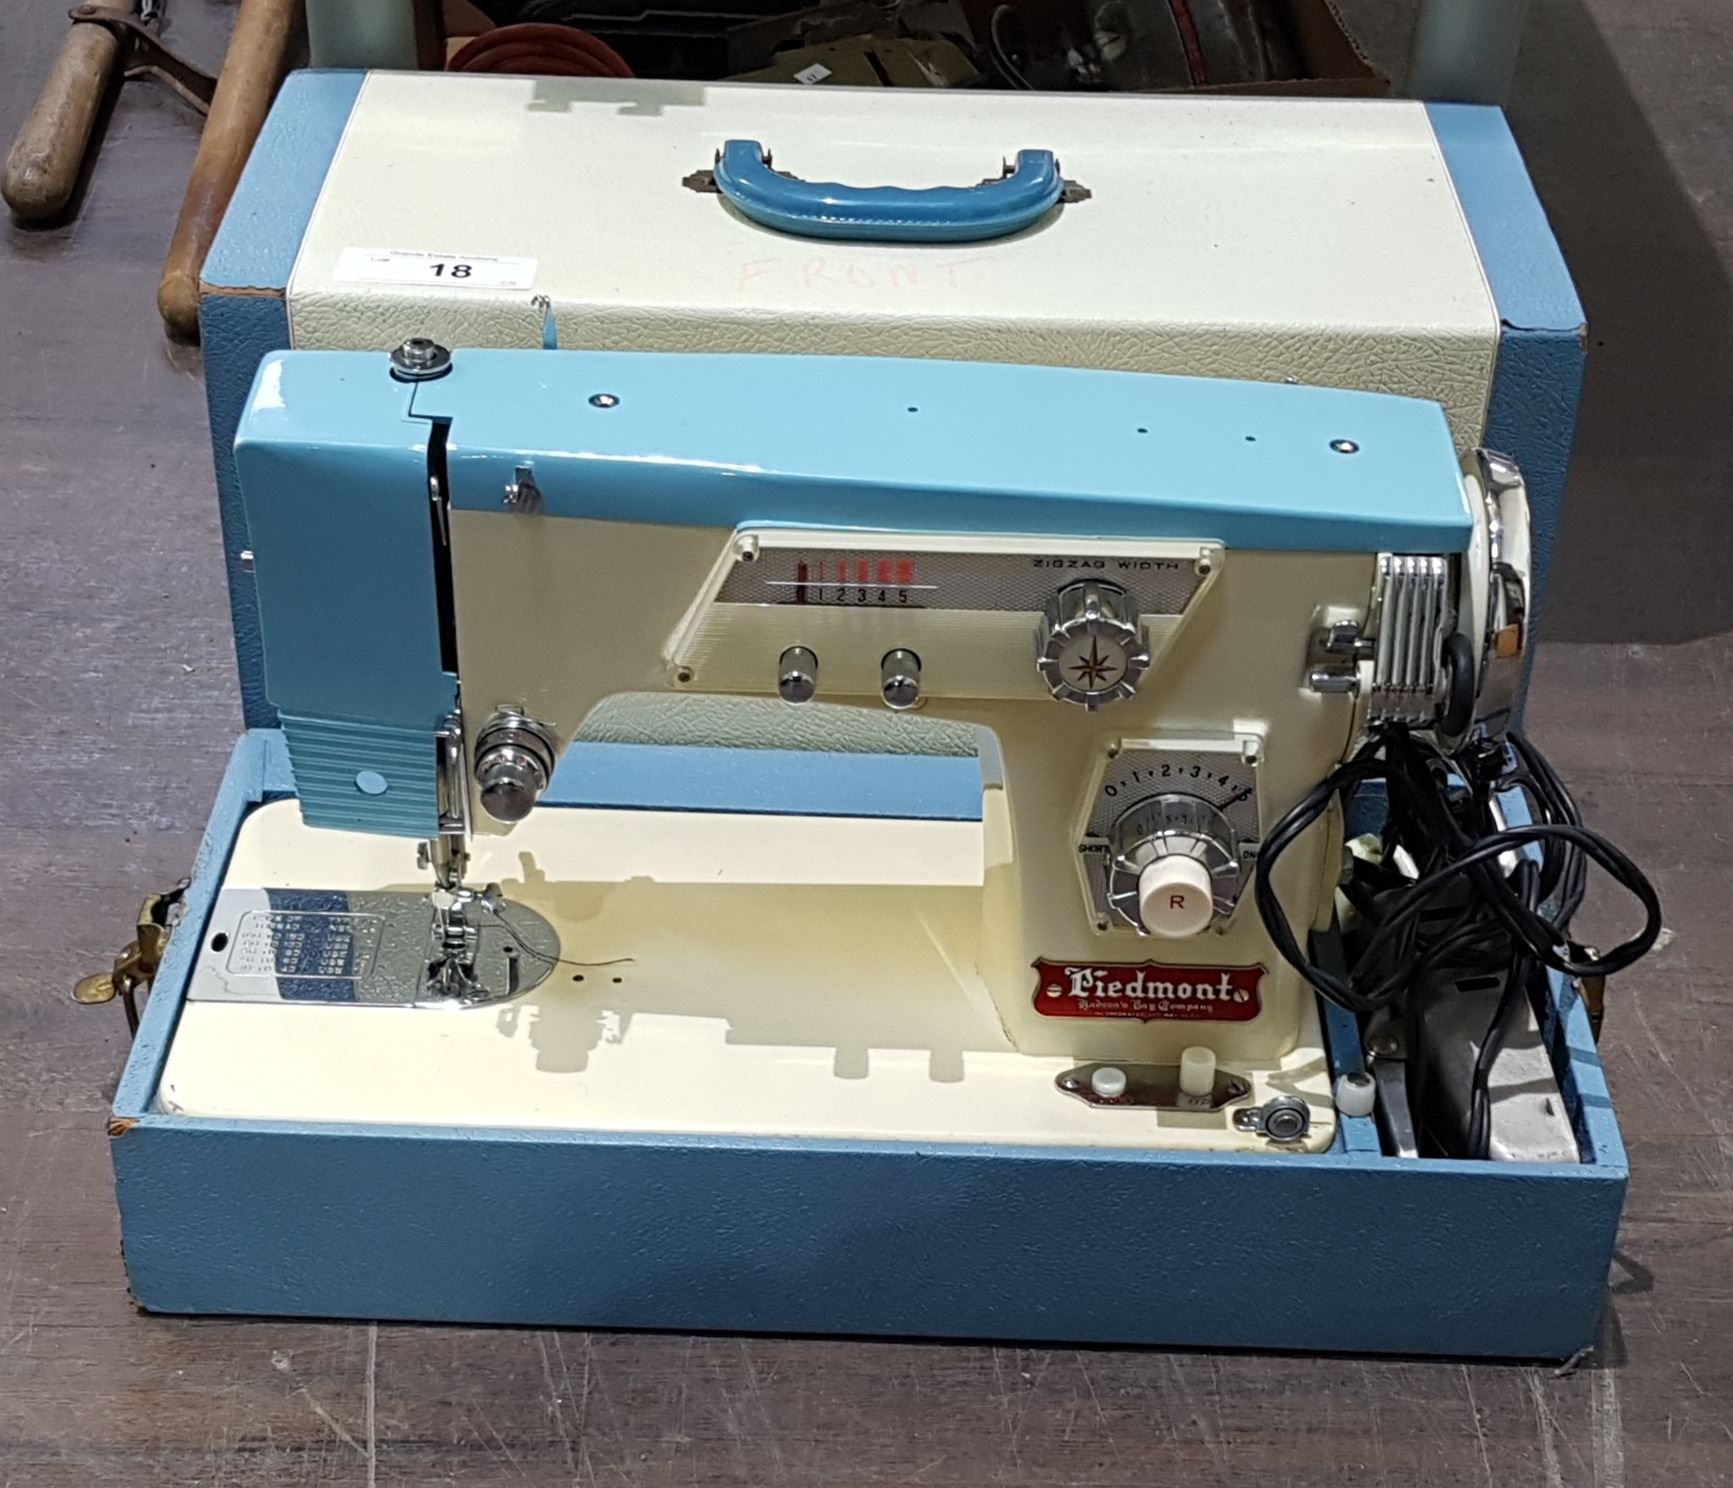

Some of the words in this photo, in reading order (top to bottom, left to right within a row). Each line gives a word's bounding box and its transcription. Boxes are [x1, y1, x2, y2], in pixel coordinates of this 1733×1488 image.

[429, 263, 472, 279] 18
[736, 256, 993, 292] FRONT
[1033, 558, 1106, 569] ZIGZAG
[1118, 561, 1179, 571] WIDTH
[836, 588, 846, 602] 2
[857, 588, 867, 602] 3
[877, 589, 886, 602] 4
[898, 589, 908, 603] 5
[1104, 784, 1118, 797] 0
[1132, 770, 1141, 784] 1
[1161, 764, 1171, 777] 2
[1189, 765, 1201, 779] 3
[1217, 775, 1230, 786] 4
[1169, 895, 1185, 909] R
[1064, 966, 1233, 1001] Piedmont
